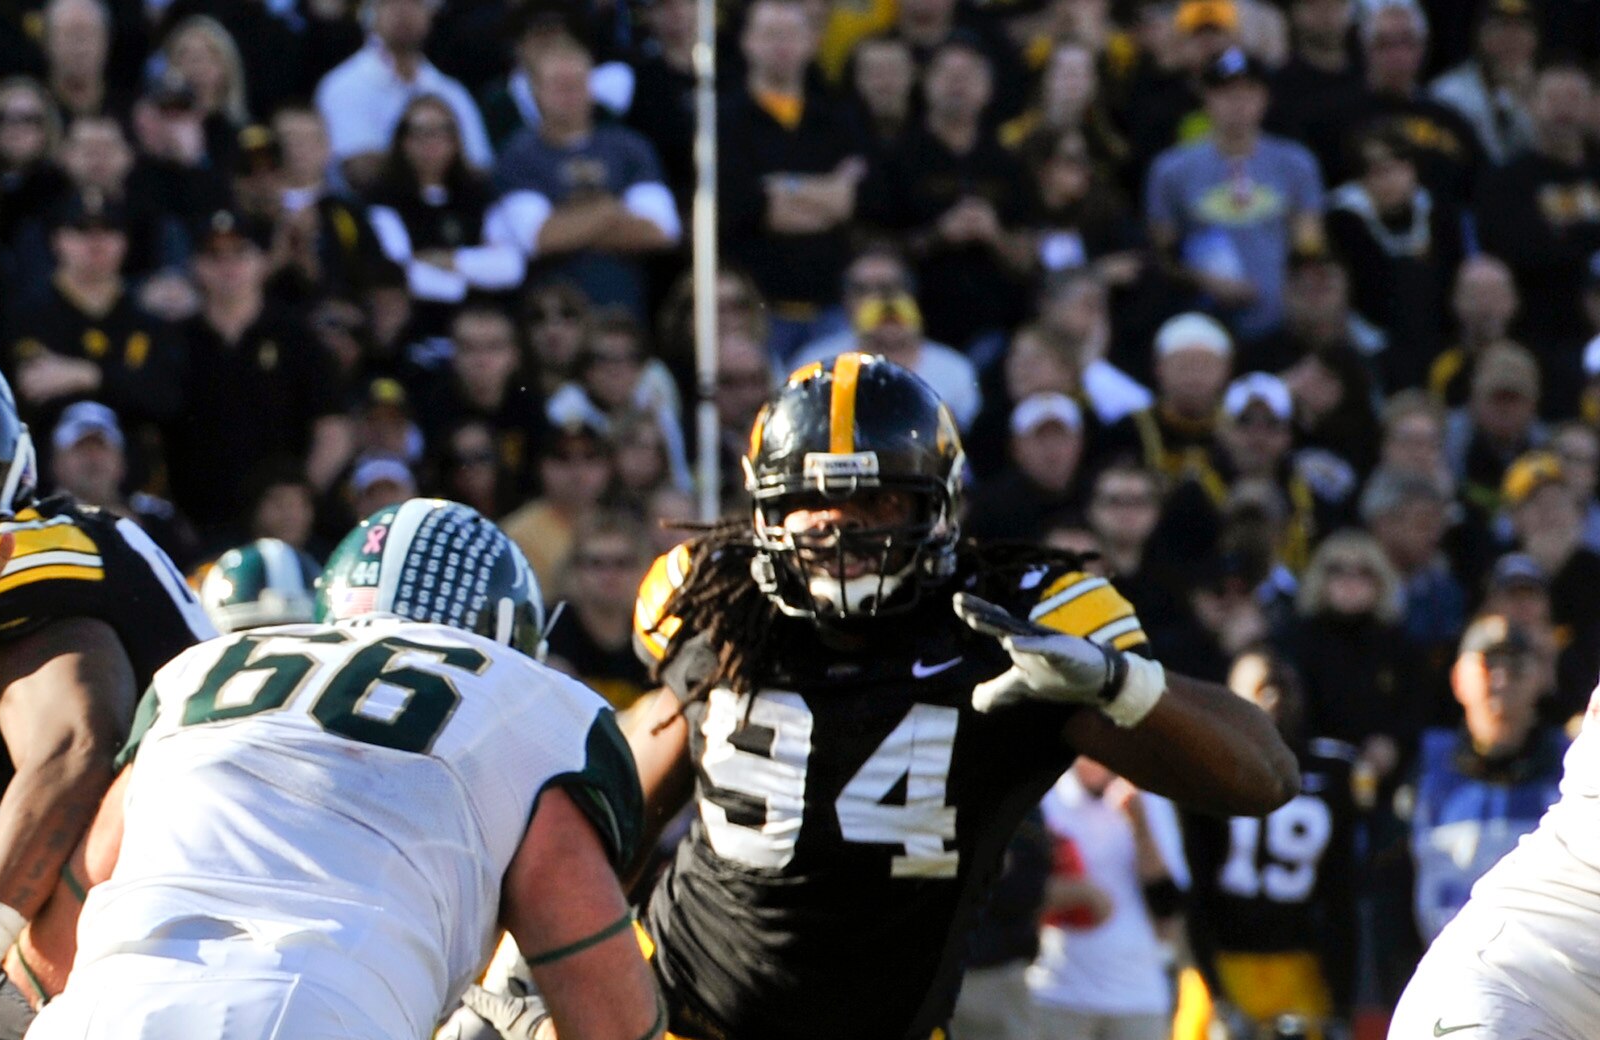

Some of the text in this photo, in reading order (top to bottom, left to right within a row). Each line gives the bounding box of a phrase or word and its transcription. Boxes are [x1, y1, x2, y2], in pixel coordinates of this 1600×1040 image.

[353, 560, 380, 586] 44
[181, 629, 493, 755] 66
[700, 687, 959, 878] 94
[1220, 794, 1332, 902] 19
